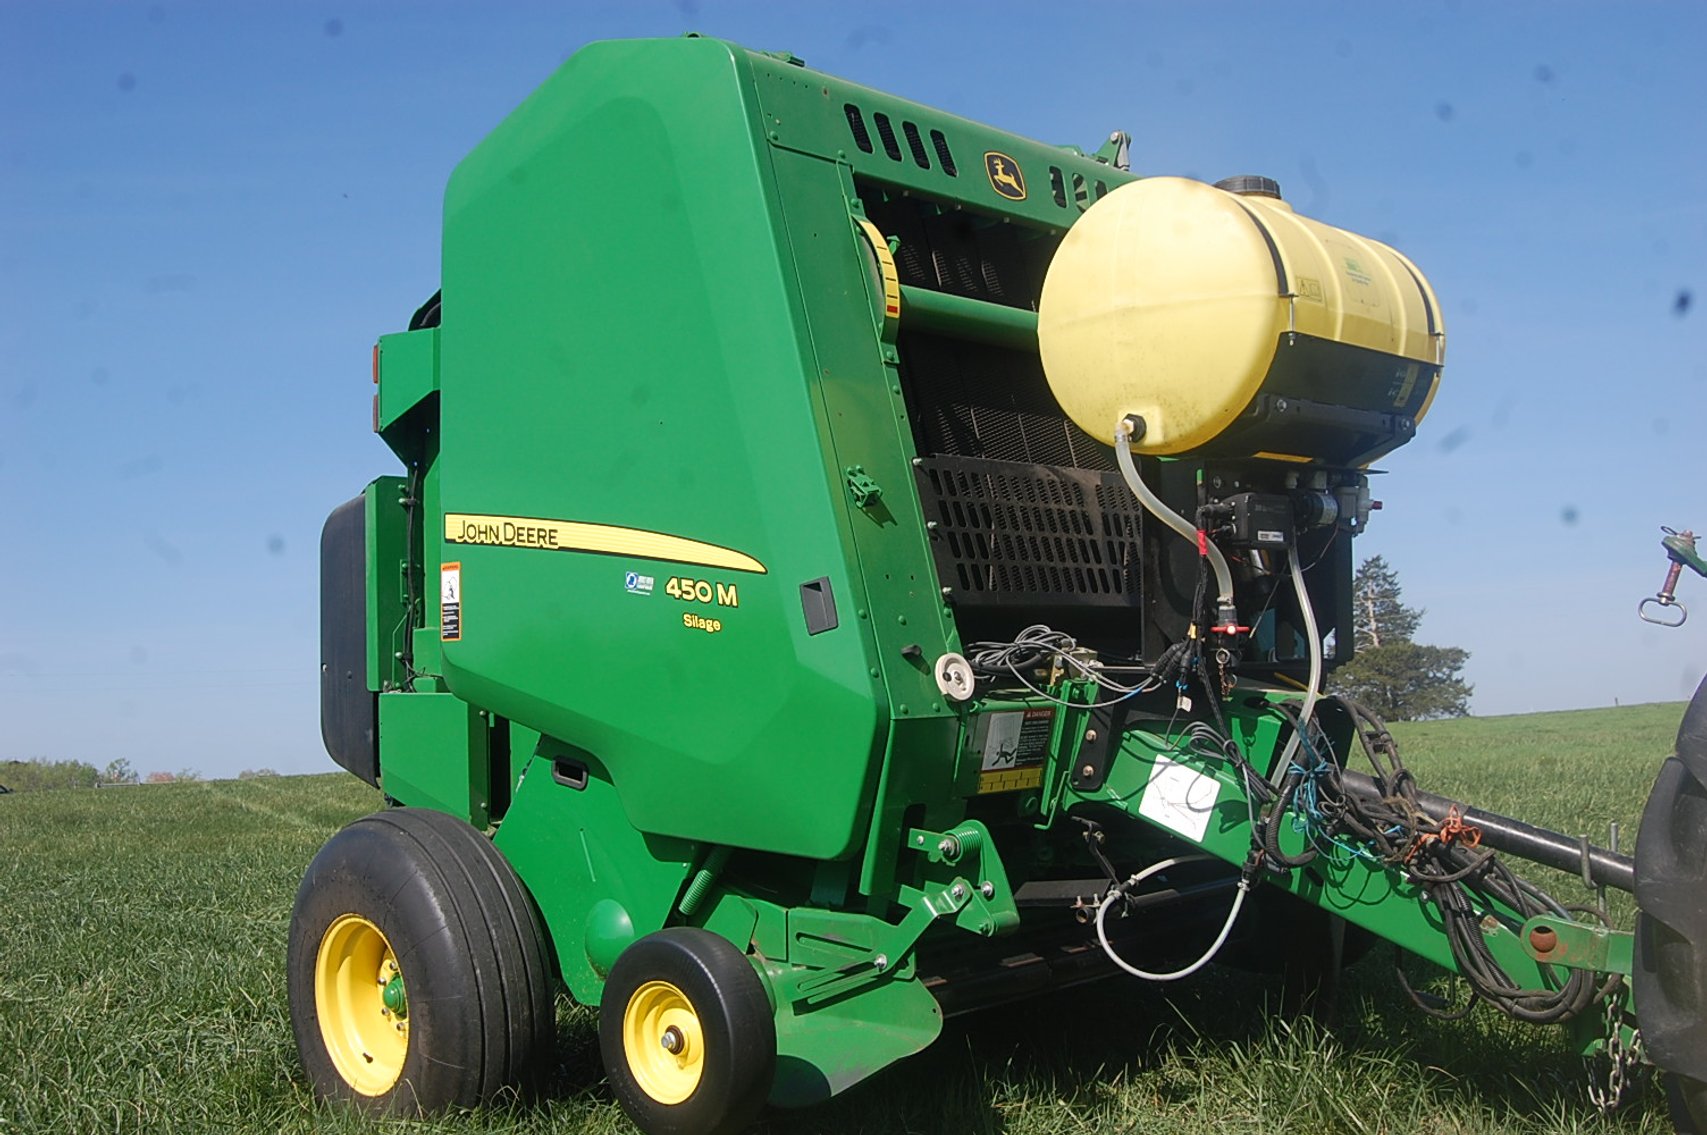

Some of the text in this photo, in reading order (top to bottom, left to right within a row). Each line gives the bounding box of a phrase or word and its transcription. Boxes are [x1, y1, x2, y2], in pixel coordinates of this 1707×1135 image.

[458, 520, 558, 546] JOHN DEERE
[665, 576, 713, 604] 450
[716, 582, 738, 608] M
[683, 612, 721, 634] Silage
